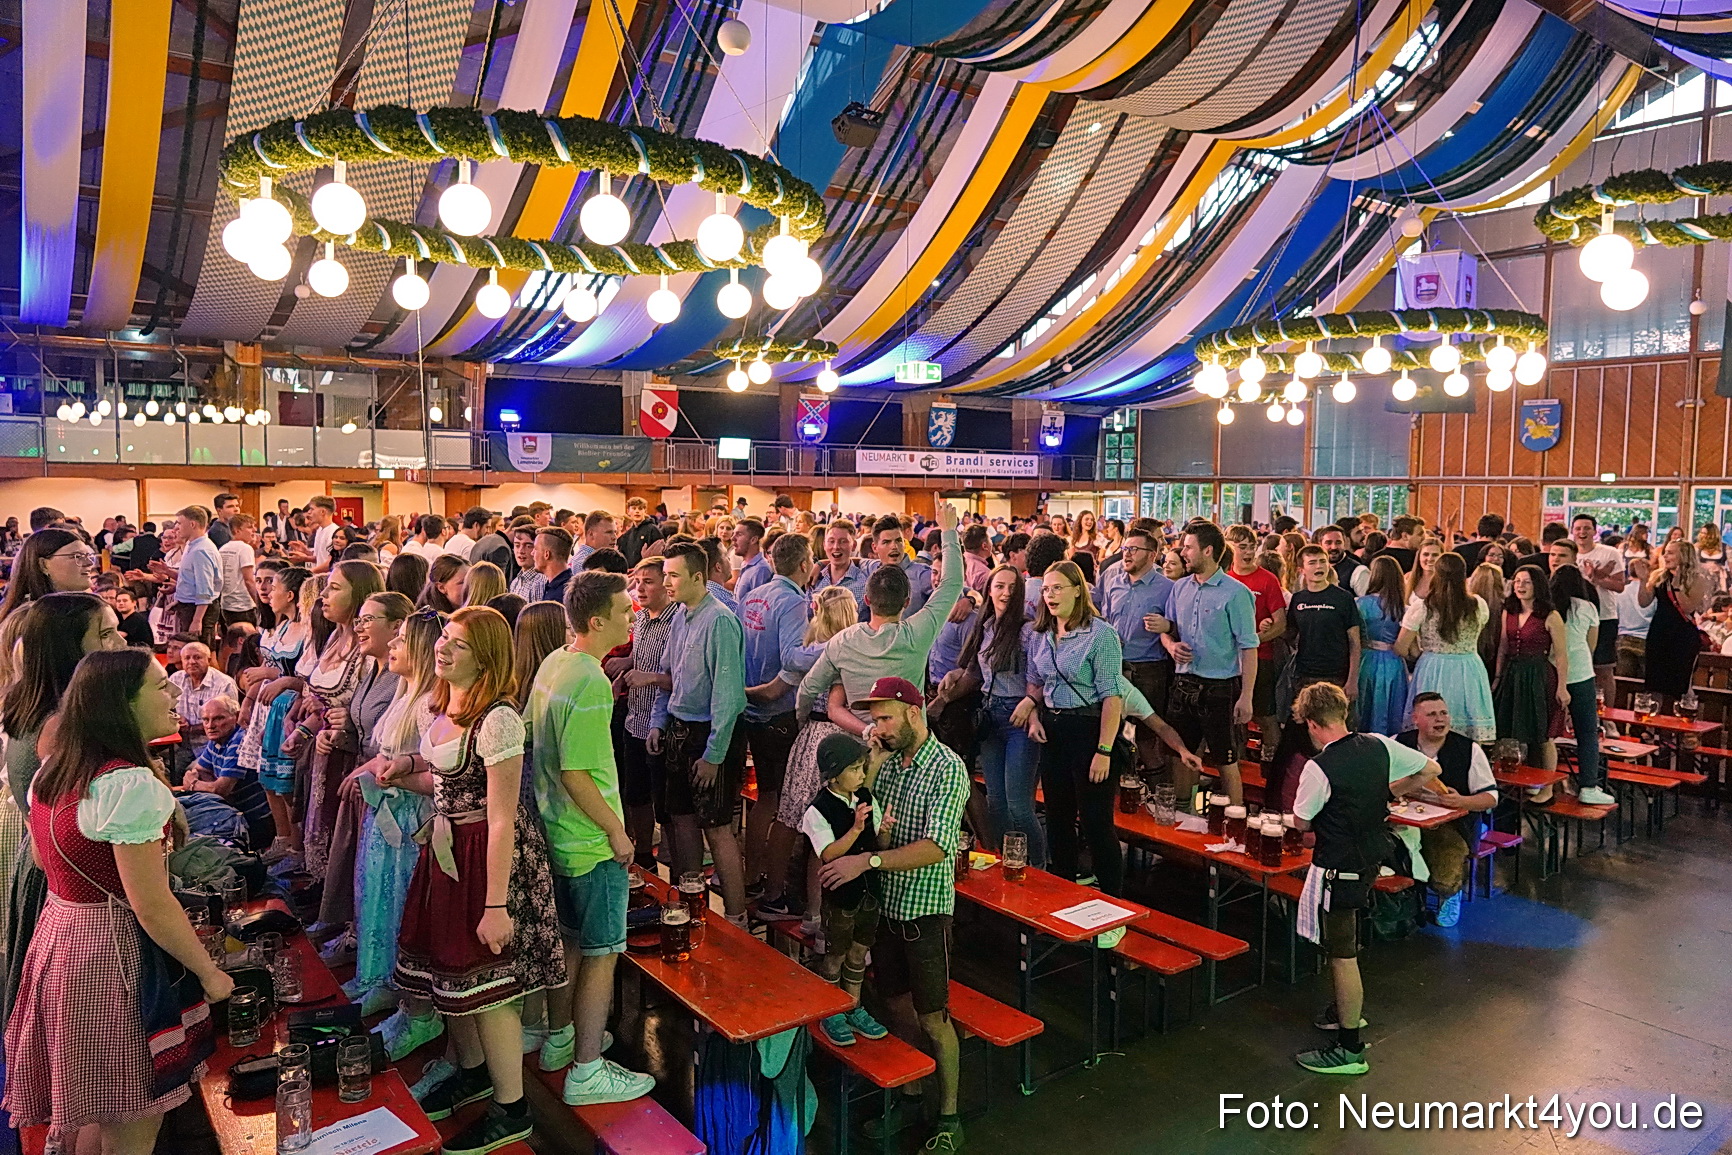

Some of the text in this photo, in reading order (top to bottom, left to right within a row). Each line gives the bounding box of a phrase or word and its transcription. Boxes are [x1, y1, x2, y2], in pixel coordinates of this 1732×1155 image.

[573, 442, 612, 450] Willkommen
[861, 452, 907, 463] NEUMARKT
[945, 455, 1034, 467] Brandl services
[1296, 603, 1335, 611] Champion
[342, 1119, 368, 1130] Milena
